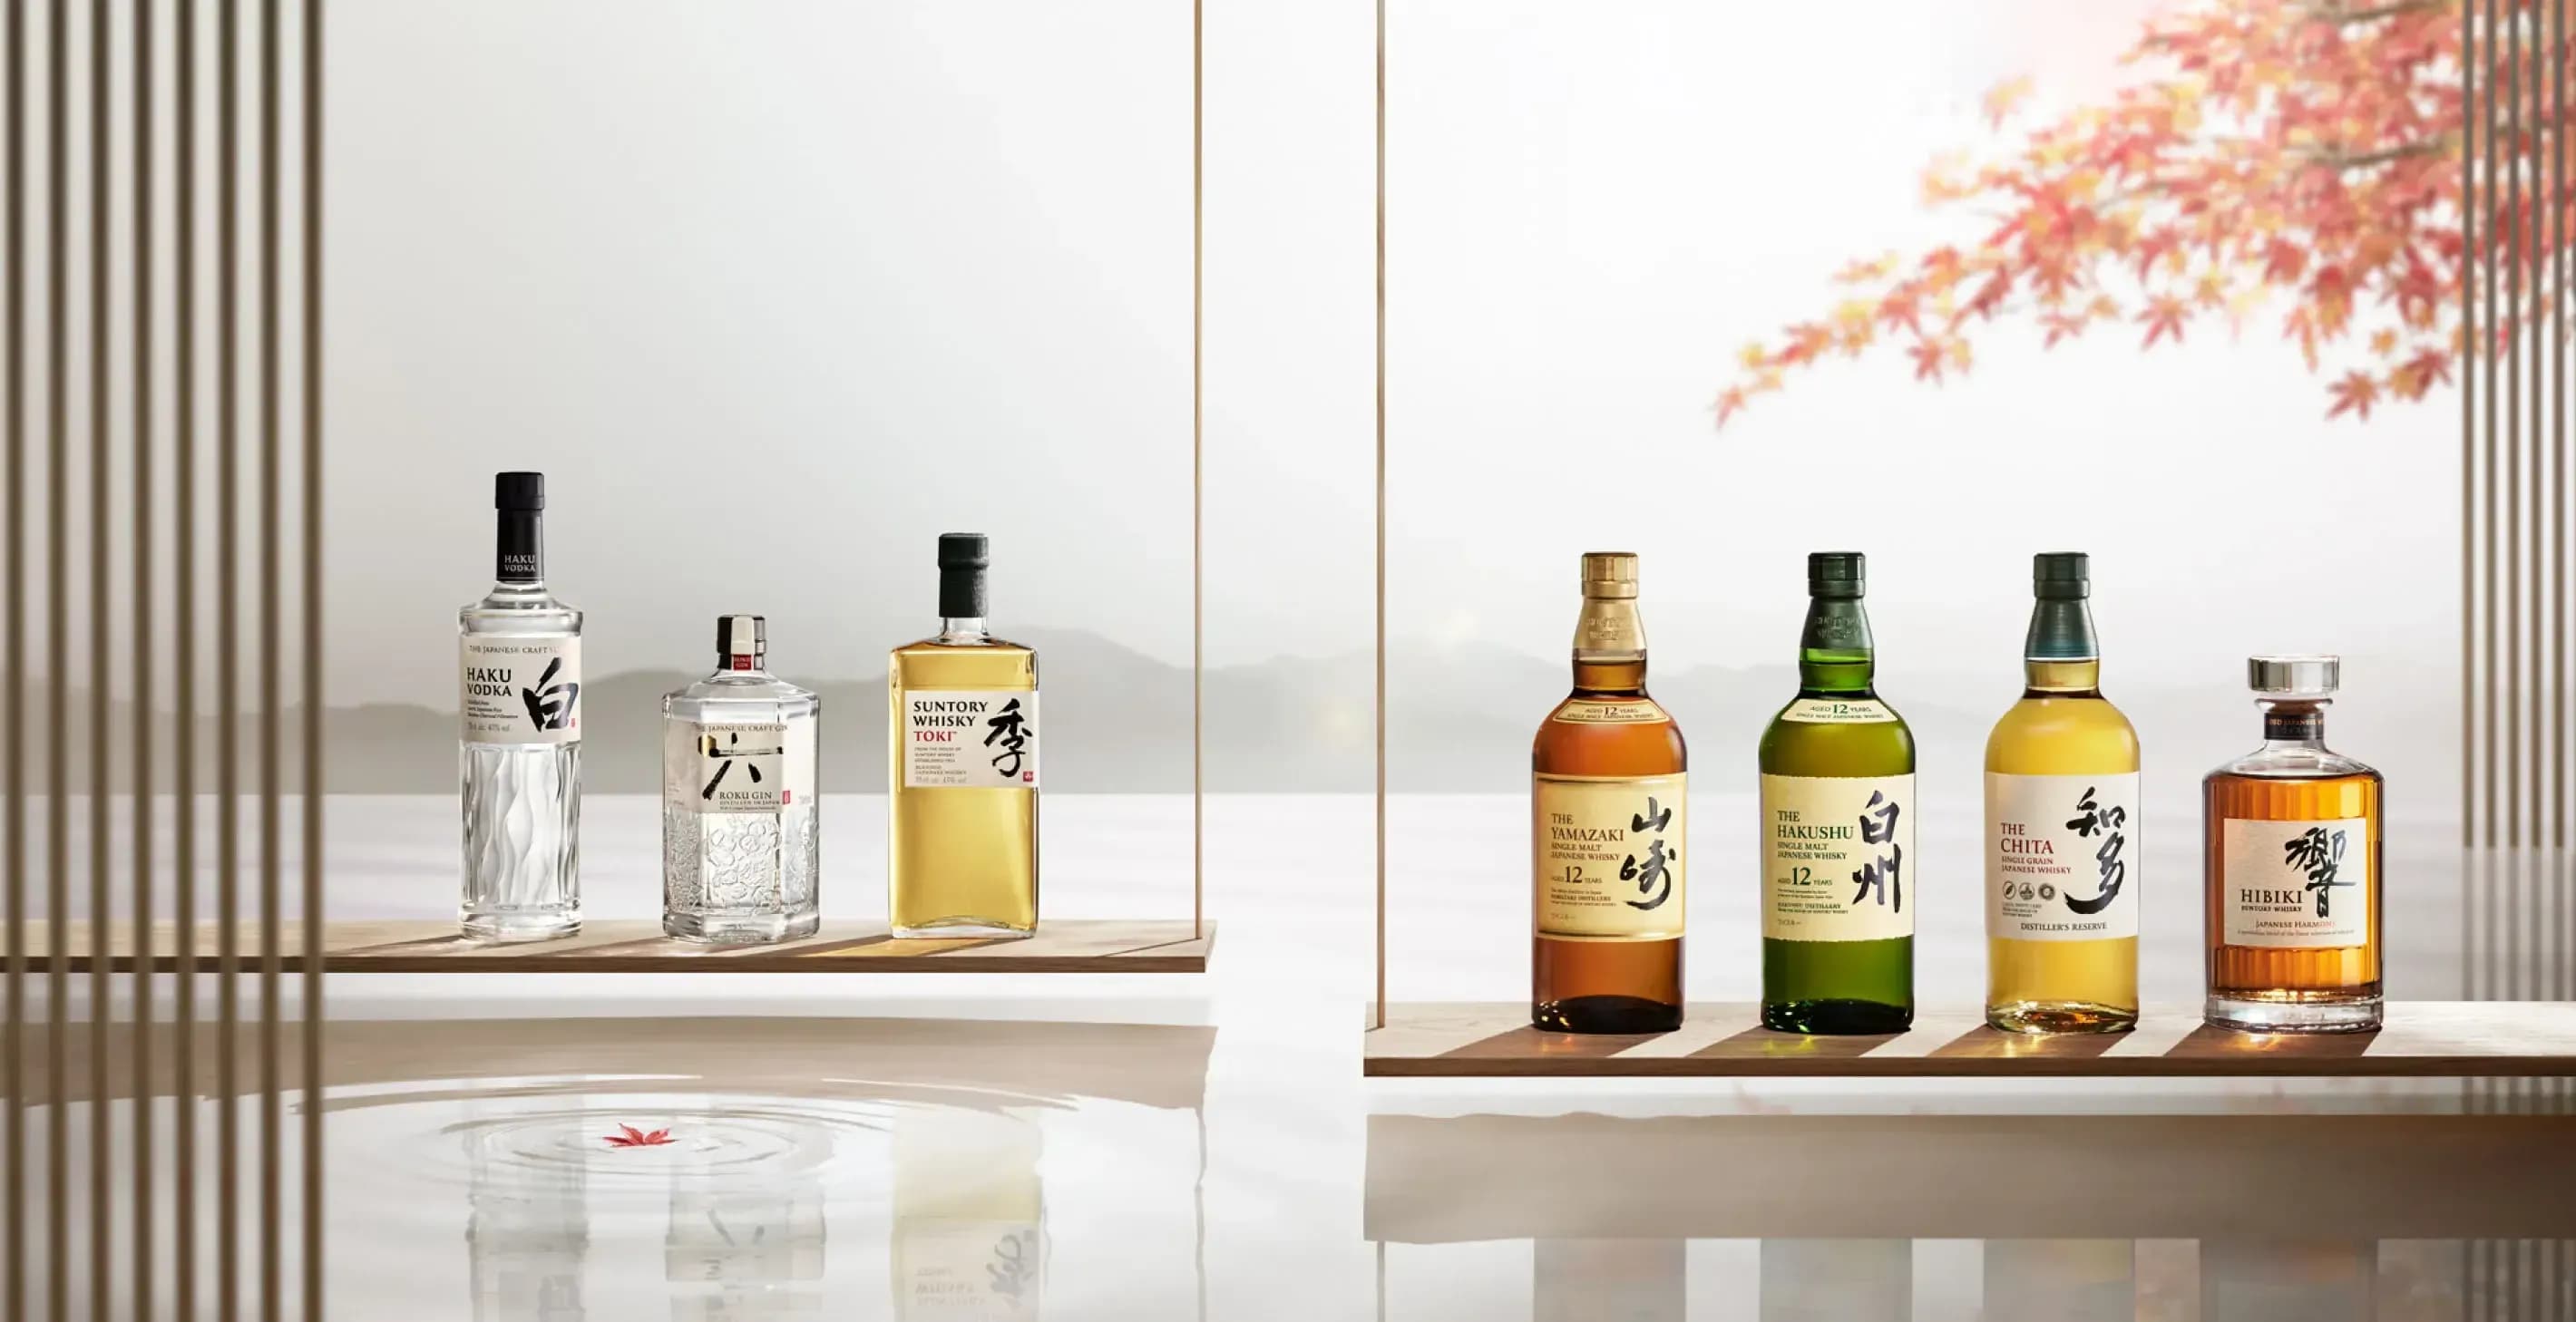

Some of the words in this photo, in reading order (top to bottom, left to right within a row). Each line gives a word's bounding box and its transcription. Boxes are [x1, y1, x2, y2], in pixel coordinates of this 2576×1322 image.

[504, 554, 536, 563] HAKU
[504, 564, 536, 572] VODKA
[467, 666, 512, 683] HAKU
[467, 683, 512, 696] VODKA
[522, 656, 579, 733] 白
[913, 701, 988, 713] SUNTORY
[1604, 706, 1618, 716] 12
[1832, 704, 1849, 714] 12
[913, 715, 976, 727] WHISKY
[983, 697, 1033, 778] 季
[702, 732, 783, 801] 六
[719, 791, 749, 800] ROKU
[751, 791, 773, 800] GIN
[1551, 813, 1574, 824] THE
[1778, 811, 1800, 822] THE
[1551, 827, 1625, 841] YAMAZAKI
[1778, 825, 1854, 840] HAKUSHU
[2001, 822, 2025, 835] THE
[1551, 842, 1577, 851] SINGLE
[1778, 841, 1803, 851] SINGLE
[1804, 842, 1830, 851] MALT
[1852, 790, 1902, 914] 白州
[2001, 838, 2054, 854] CHITA
[2064, 785, 2126, 915] 知多
[1551, 851, 1586, 860] JAPANESE
[1587, 853, 1620, 861] WHISKY
[1778, 851, 1813, 860] JAPANESE
[1814, 851, 1848, 860] WHISKY
[2002, 855, 2025, 864] SINGLE
[2026, 857, 2054, 865] GRAIN
[1565, 865, 1583, 884] 12
[2002, 865, 2036, 873] JAPANESE
[2284, 826, 2357, 919] 響
[1791, 866, 1811, 886] 12
[2240, 889, 2304, 904] HIBIKI
[2072, 921, 2108, 930] RESERVE
[2256, 920, 2292, 928] JAPANESE
